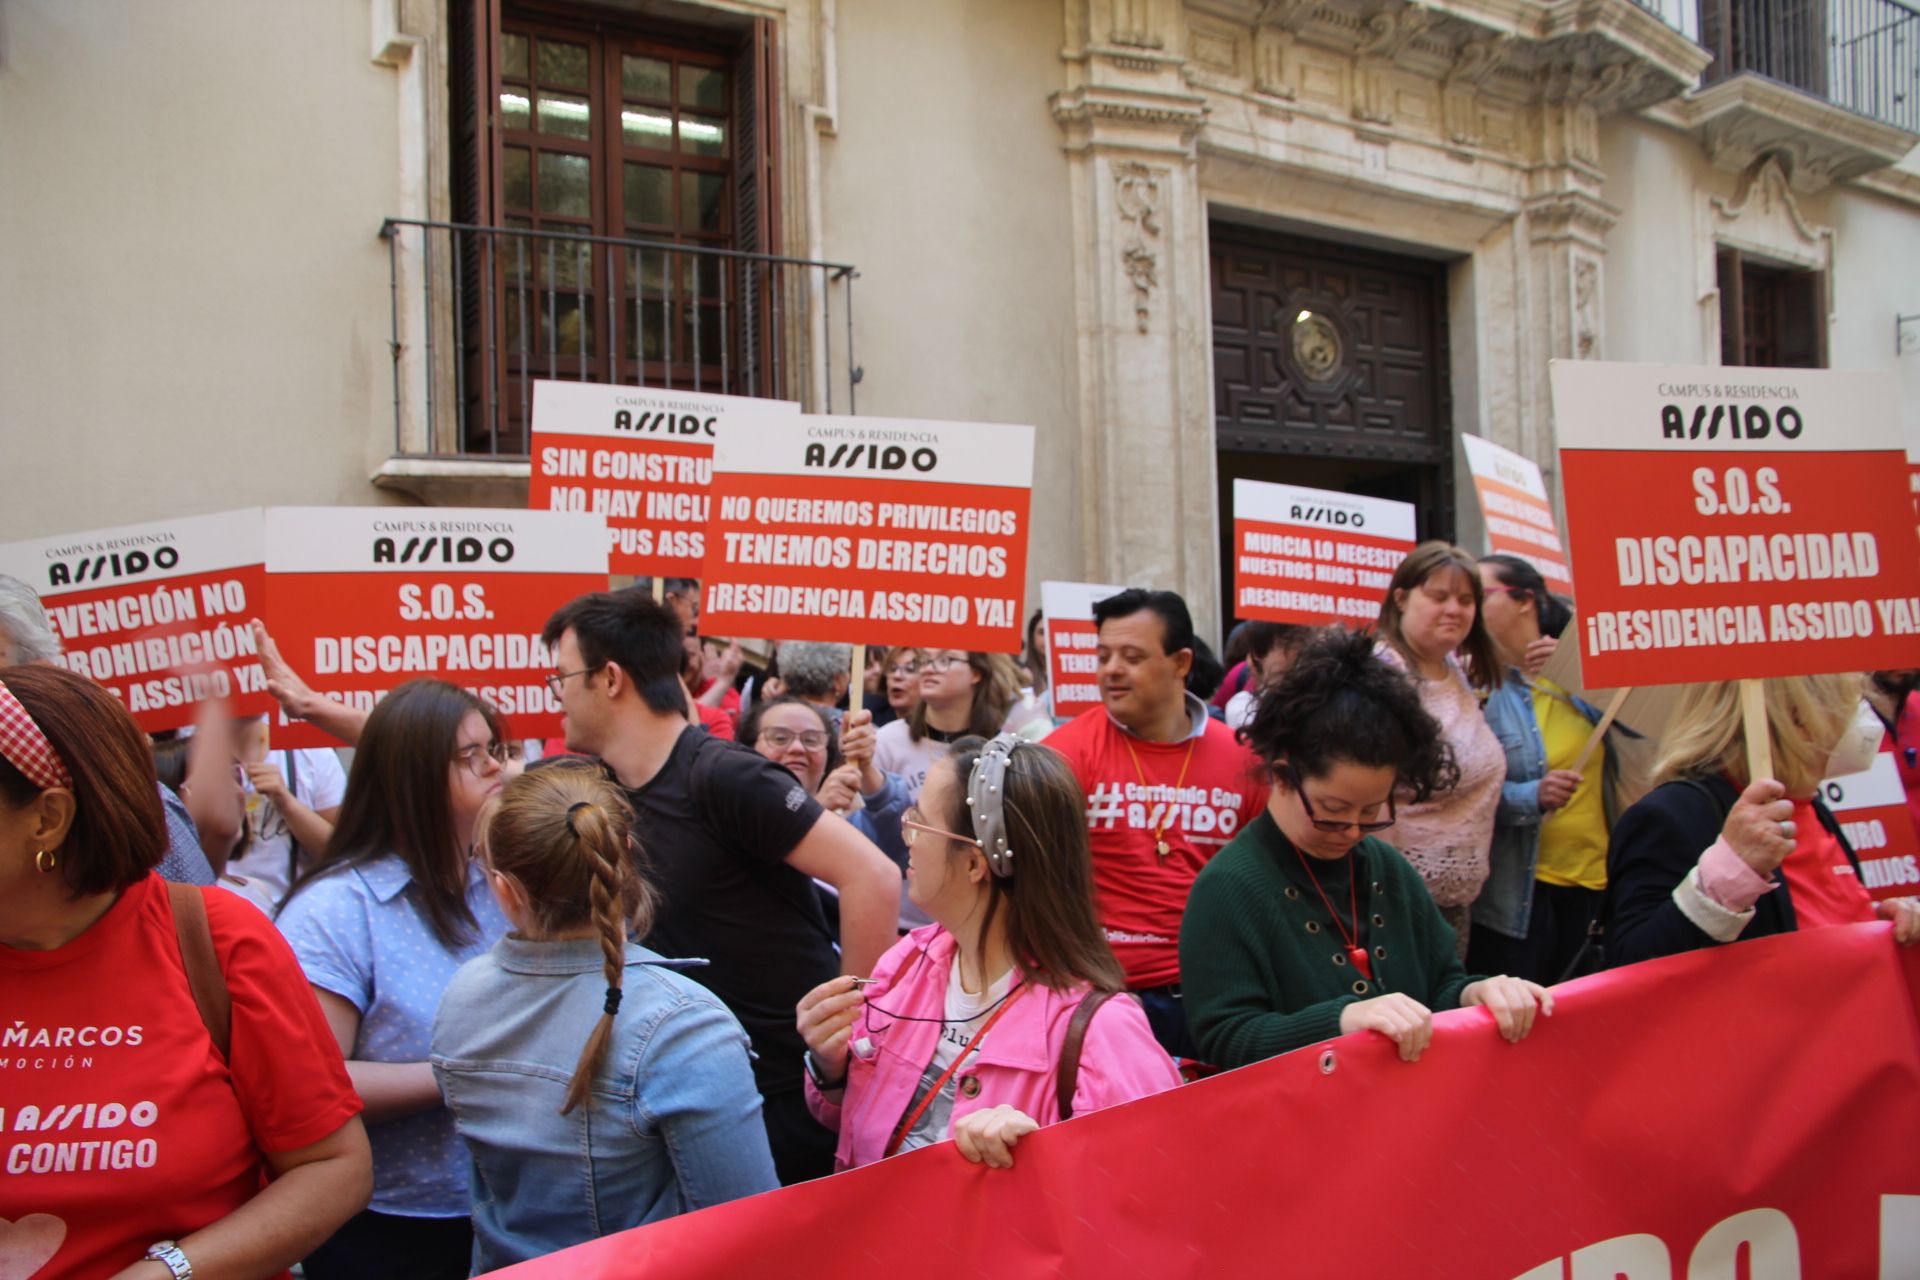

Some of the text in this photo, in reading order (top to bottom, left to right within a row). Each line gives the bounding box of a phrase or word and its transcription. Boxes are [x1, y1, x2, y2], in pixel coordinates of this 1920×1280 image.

[615, 396, 656, 408] CAMPUS
[667, 401, 725, 413] RESIDENCIA
[1658, 383, 1800, 399] CAMPUS & RESIDENCIA
[807, 427, 939, 443] CAMPUS & RESIDENCIA
[1661, 405, 1803, 440] ASSIDO
[541, 447, 713, 485] SIN CONSTRU
[804, 443, 938, 472] ASSIDO
[550, 486, 711, 522] NO HAY INCL
[1692, 467, 1791, 516] S.O.S.
[373, 521, 514, 534] CAMPUS & RESIDENCIA
[720, 496, 1017, 535] NO QUEREMOS PRIVILEGIOS
[1291, 505, 1364, 527] ASSIDO
[46, 543, 94, 559] CAMPUS
[106, 531, 177, 551] RESIDENCIA
[374, 537, 515, 563] ASSIDO
[608, 527, 705, 559] PUS ASS
[724, 532, 1008, 578] TENEMOS DERECHOS
[1244, 531, 1313, 558] MURCIA
[1314, 539, 1334, 560] LO
[49, 546, 179, 586] ASSIDO
[1239, 556, 1314, 580] NUESTROS
[1616, 532, 1880, 587] DISCAPACIDAD
[201, 580, 247, 617] NO
[399, 583, 495, 621] S.O.S.
[706, 583, 1016, 628] ¡RESIDENCIA ASSIDO YA!
[1240, 587, 1336, 615] ¡RESIDENCIA
[1587, 606, 1766, 656] ¡RESIDENCIA
[1770, 600, 1874, 642] ASSIDO
[130, 669, 231, 712] ASSIDO
[1127, 803, 1238, 834] ASSIDO
[2, 1025, 144, 1047] MARCOS
[0, 1055, 93, 1069] MOCIÓN
[14, 1101, 158, 1131] ASSIDO
[7, 1138, 158, 1174] CONTIGO
